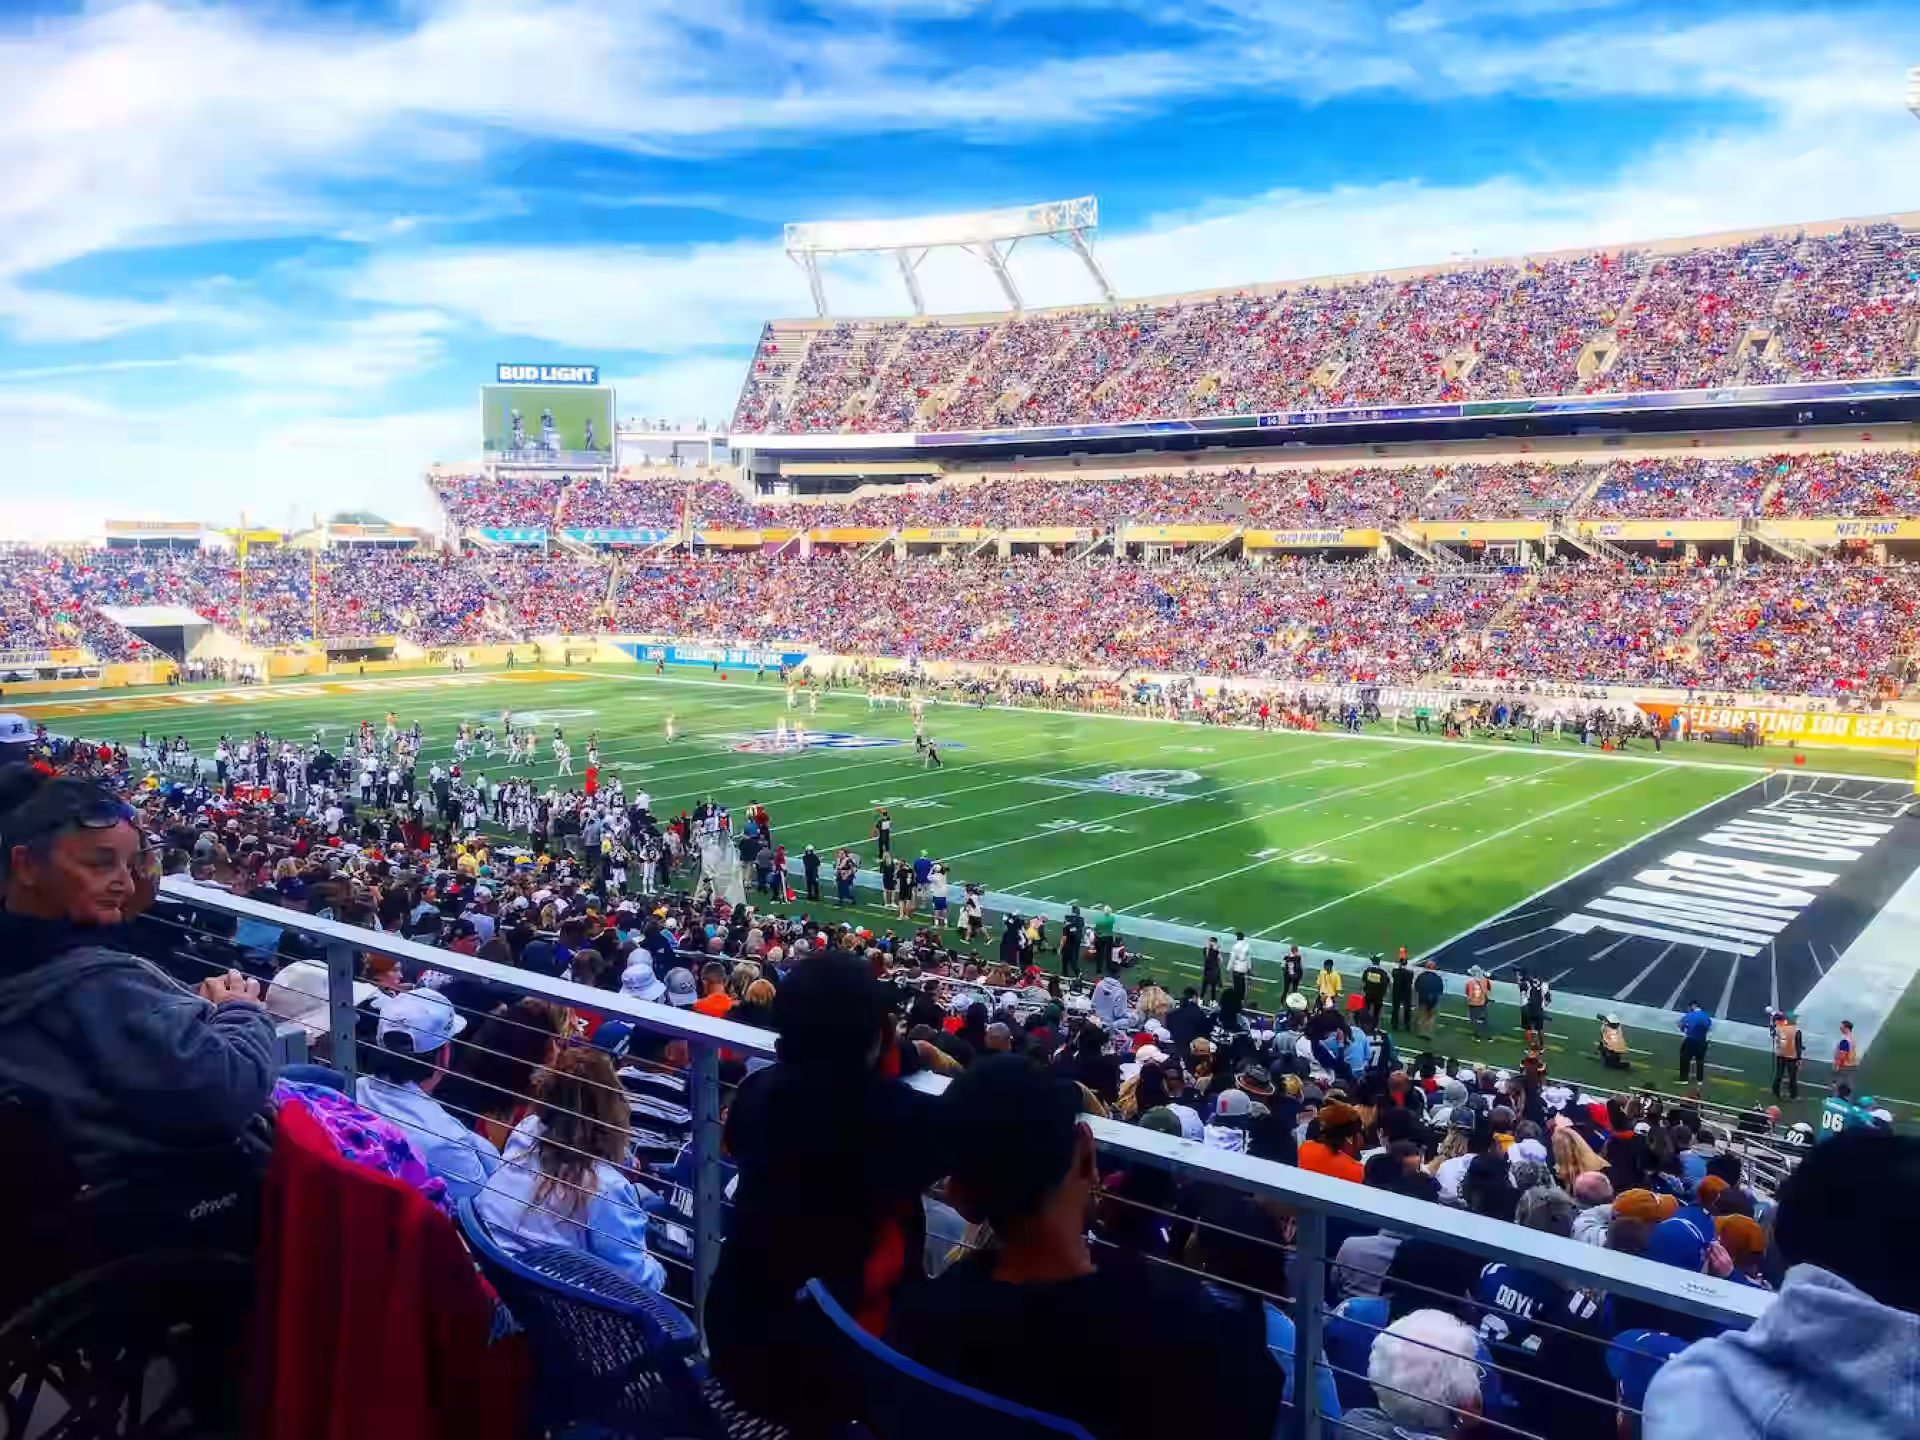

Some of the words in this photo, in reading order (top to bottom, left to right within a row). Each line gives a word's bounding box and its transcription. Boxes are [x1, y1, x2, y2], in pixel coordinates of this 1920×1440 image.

[500, 365, 539, 380] BUD
[541, 366, 594, 381] LIGHT
[1677, 707, 1805, 733] CELEBRATING
[1811, 714, 1848, 737] 100
[1495, 1284, 1543, 1319] DOYL
